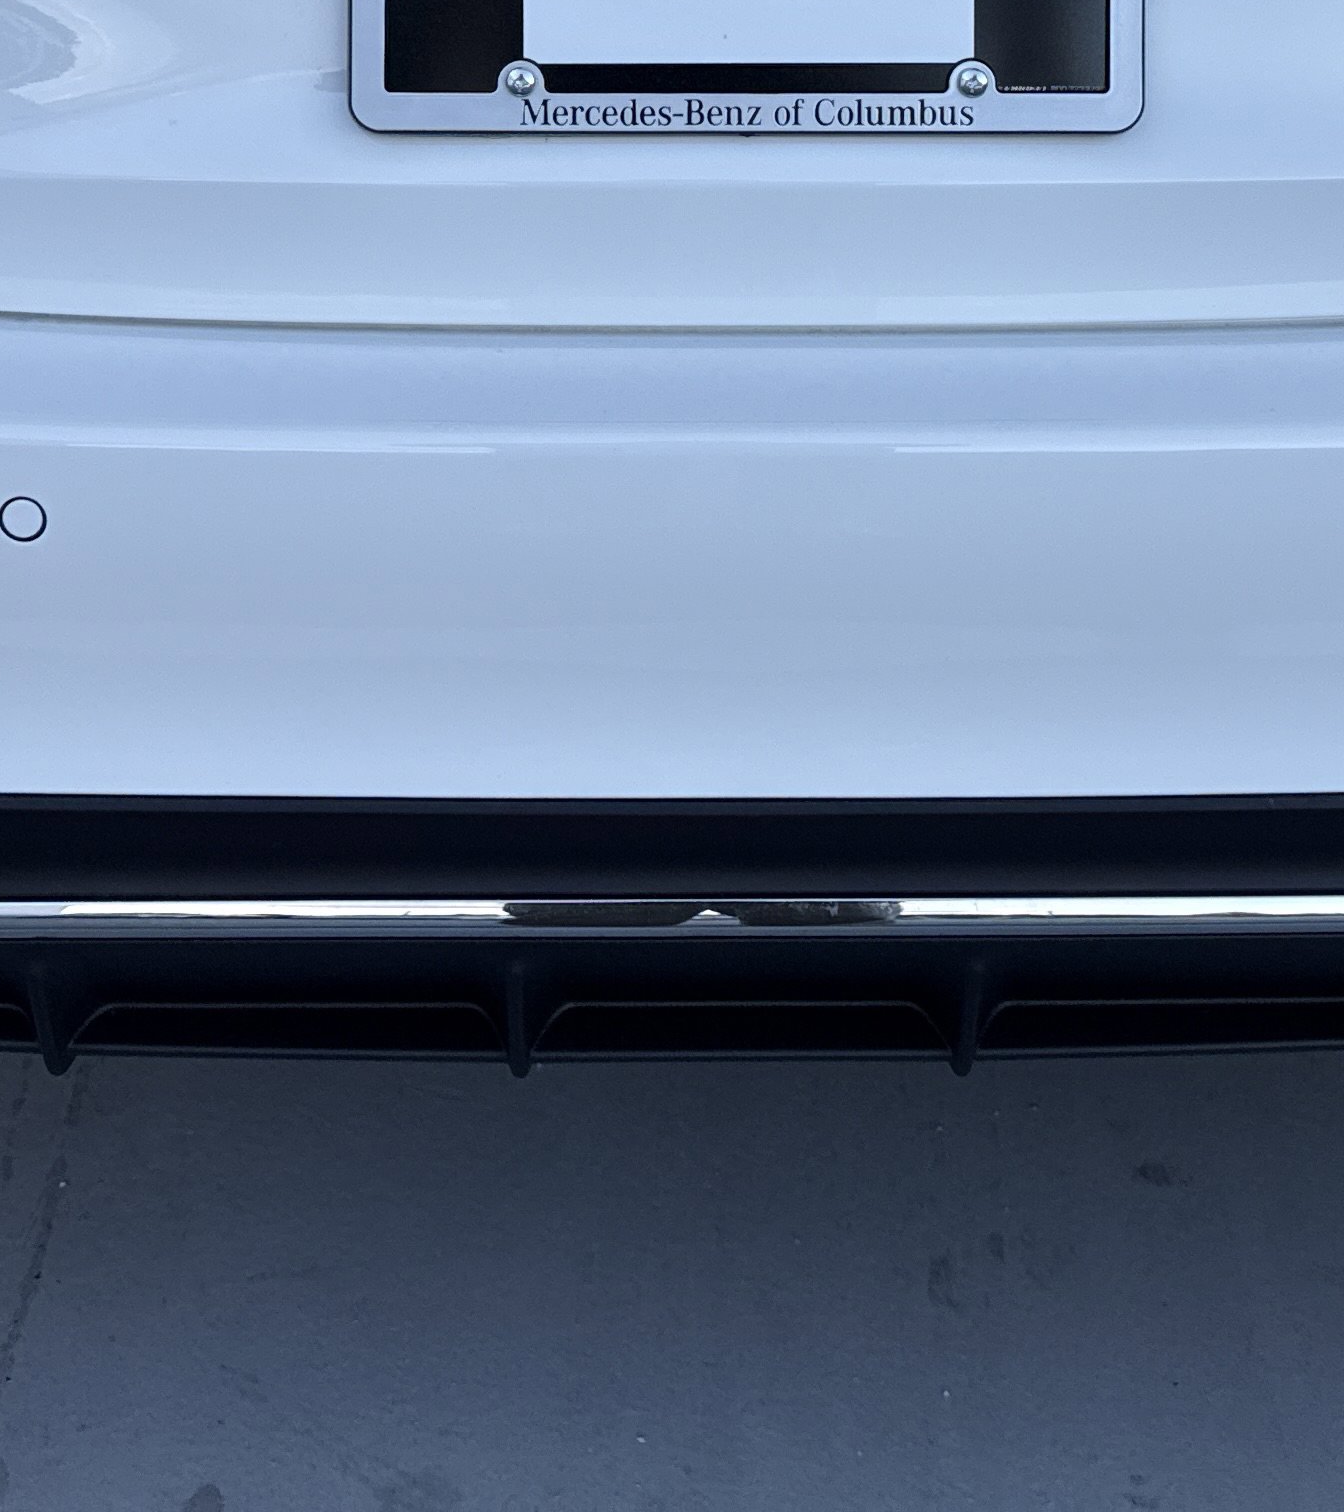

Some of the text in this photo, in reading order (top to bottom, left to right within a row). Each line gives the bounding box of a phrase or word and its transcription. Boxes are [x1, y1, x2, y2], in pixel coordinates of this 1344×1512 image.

[520, 97, 976, 127] Mercedes-Benz of Columbus
